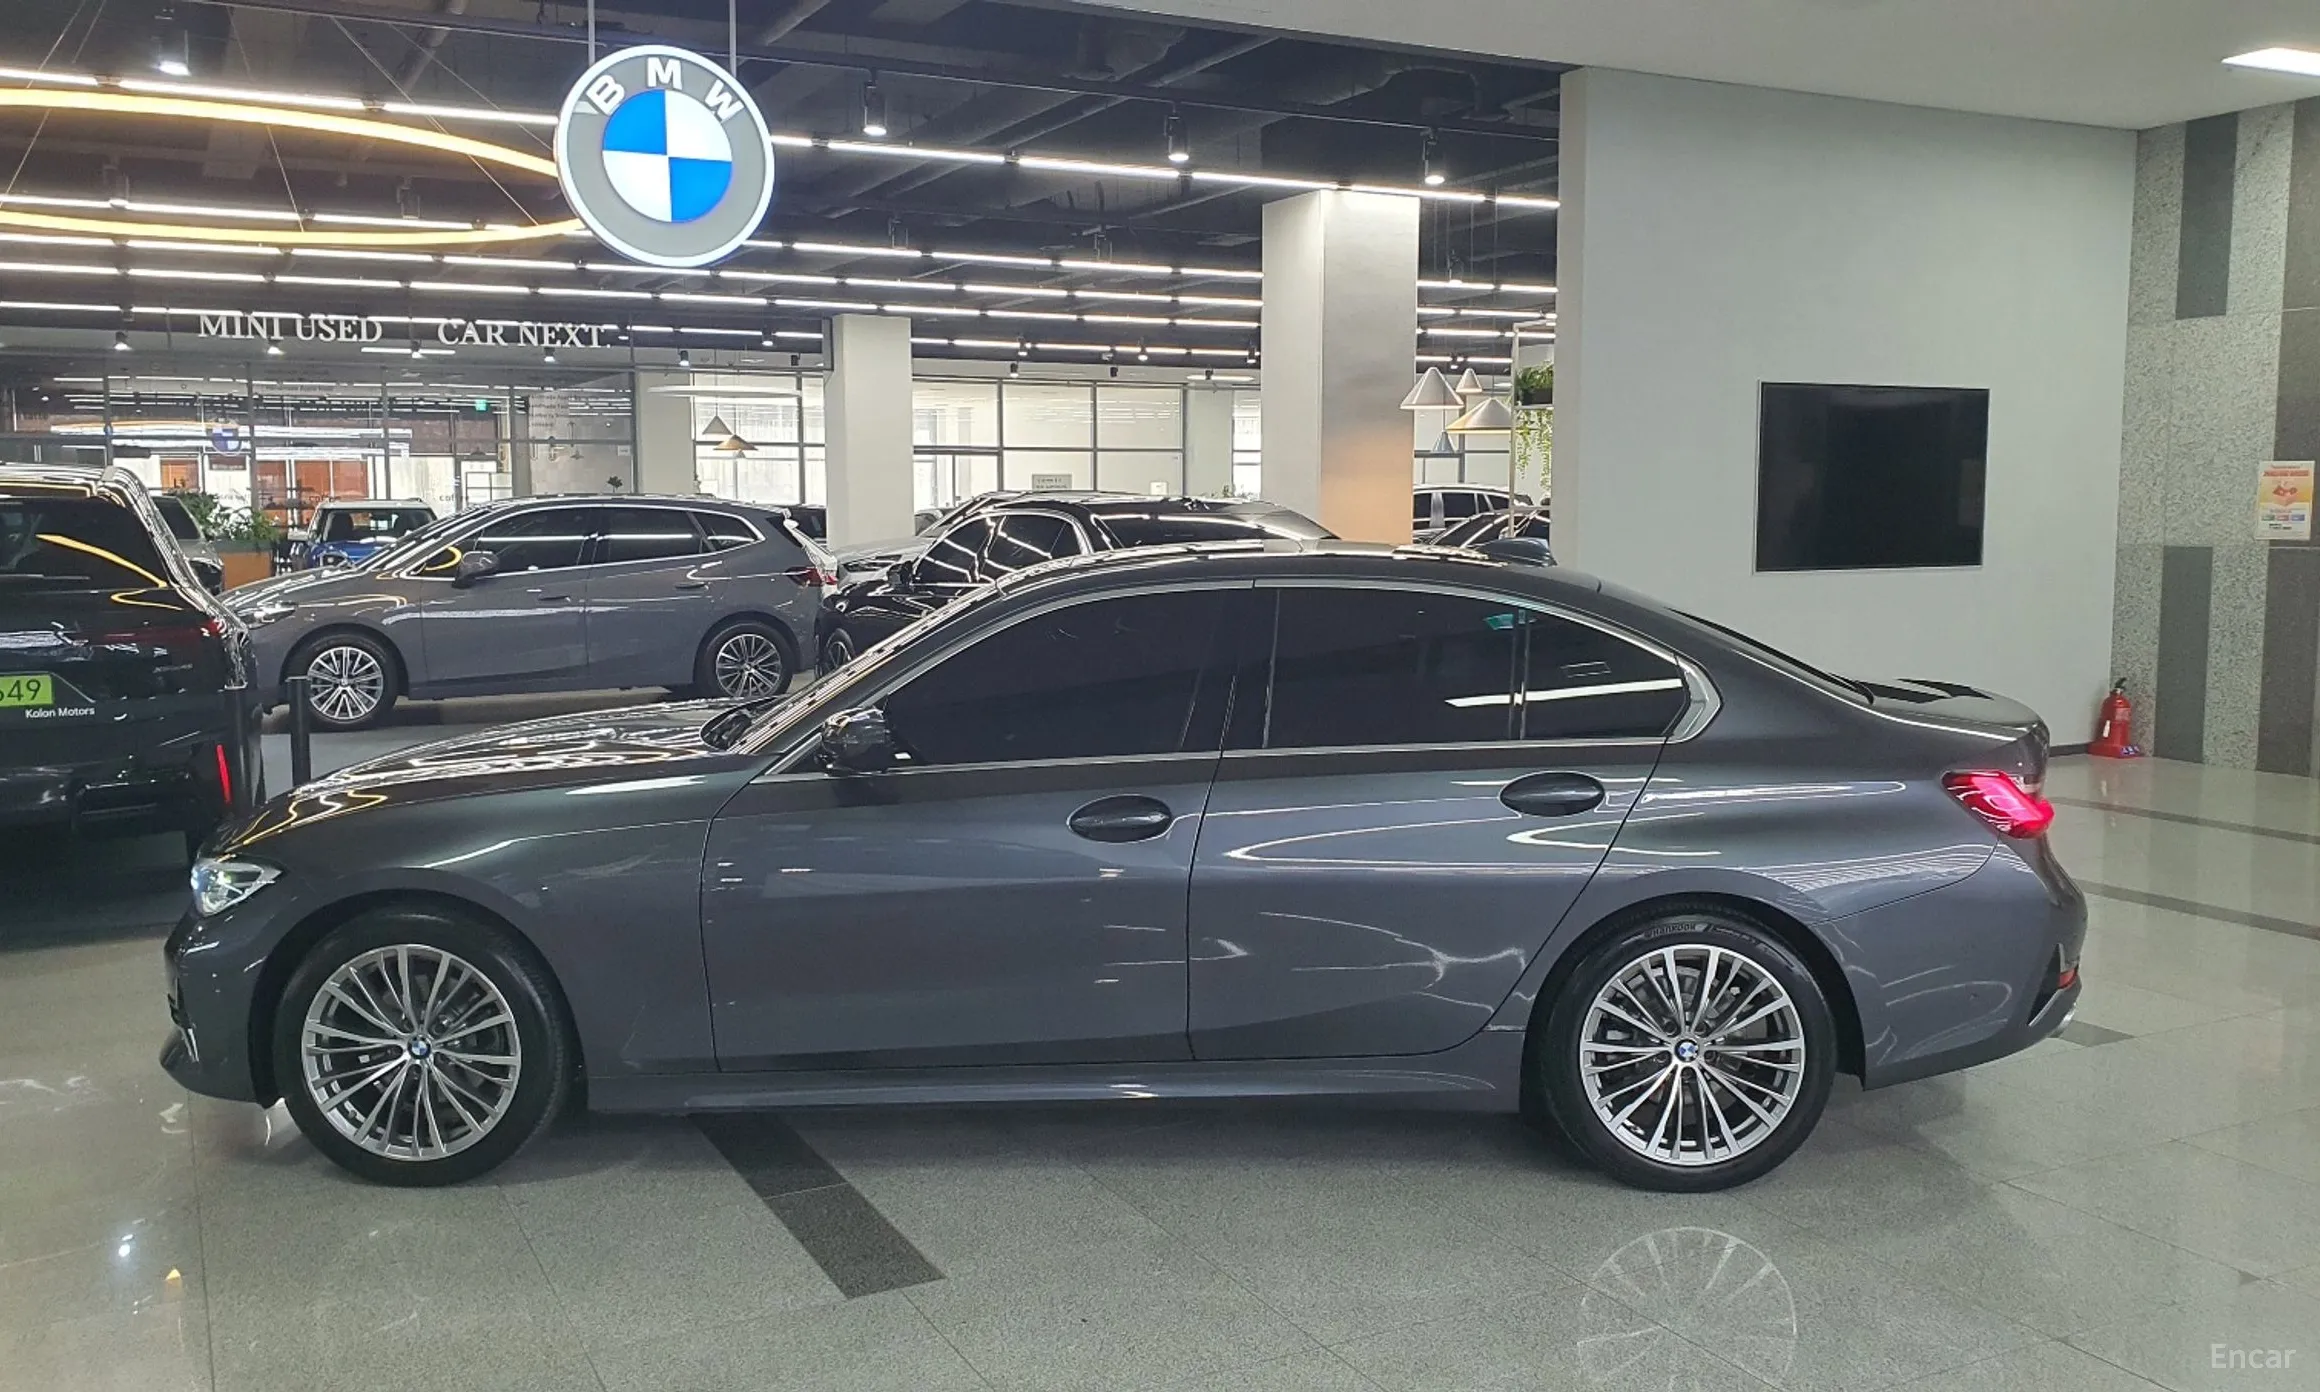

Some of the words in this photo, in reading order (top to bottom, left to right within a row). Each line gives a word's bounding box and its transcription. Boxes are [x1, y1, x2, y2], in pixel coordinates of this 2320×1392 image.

[586, 57, 745, 122] BMW
[198, 314, 284, 340] MINI
[295, 316, 383, 343] USED
[437, 321, 508, 346] CAR
[517, 322, 612, 348] NEXT.
[25, 708, 56, 719] Kolon
[58, 706, 96, 718] Motors
